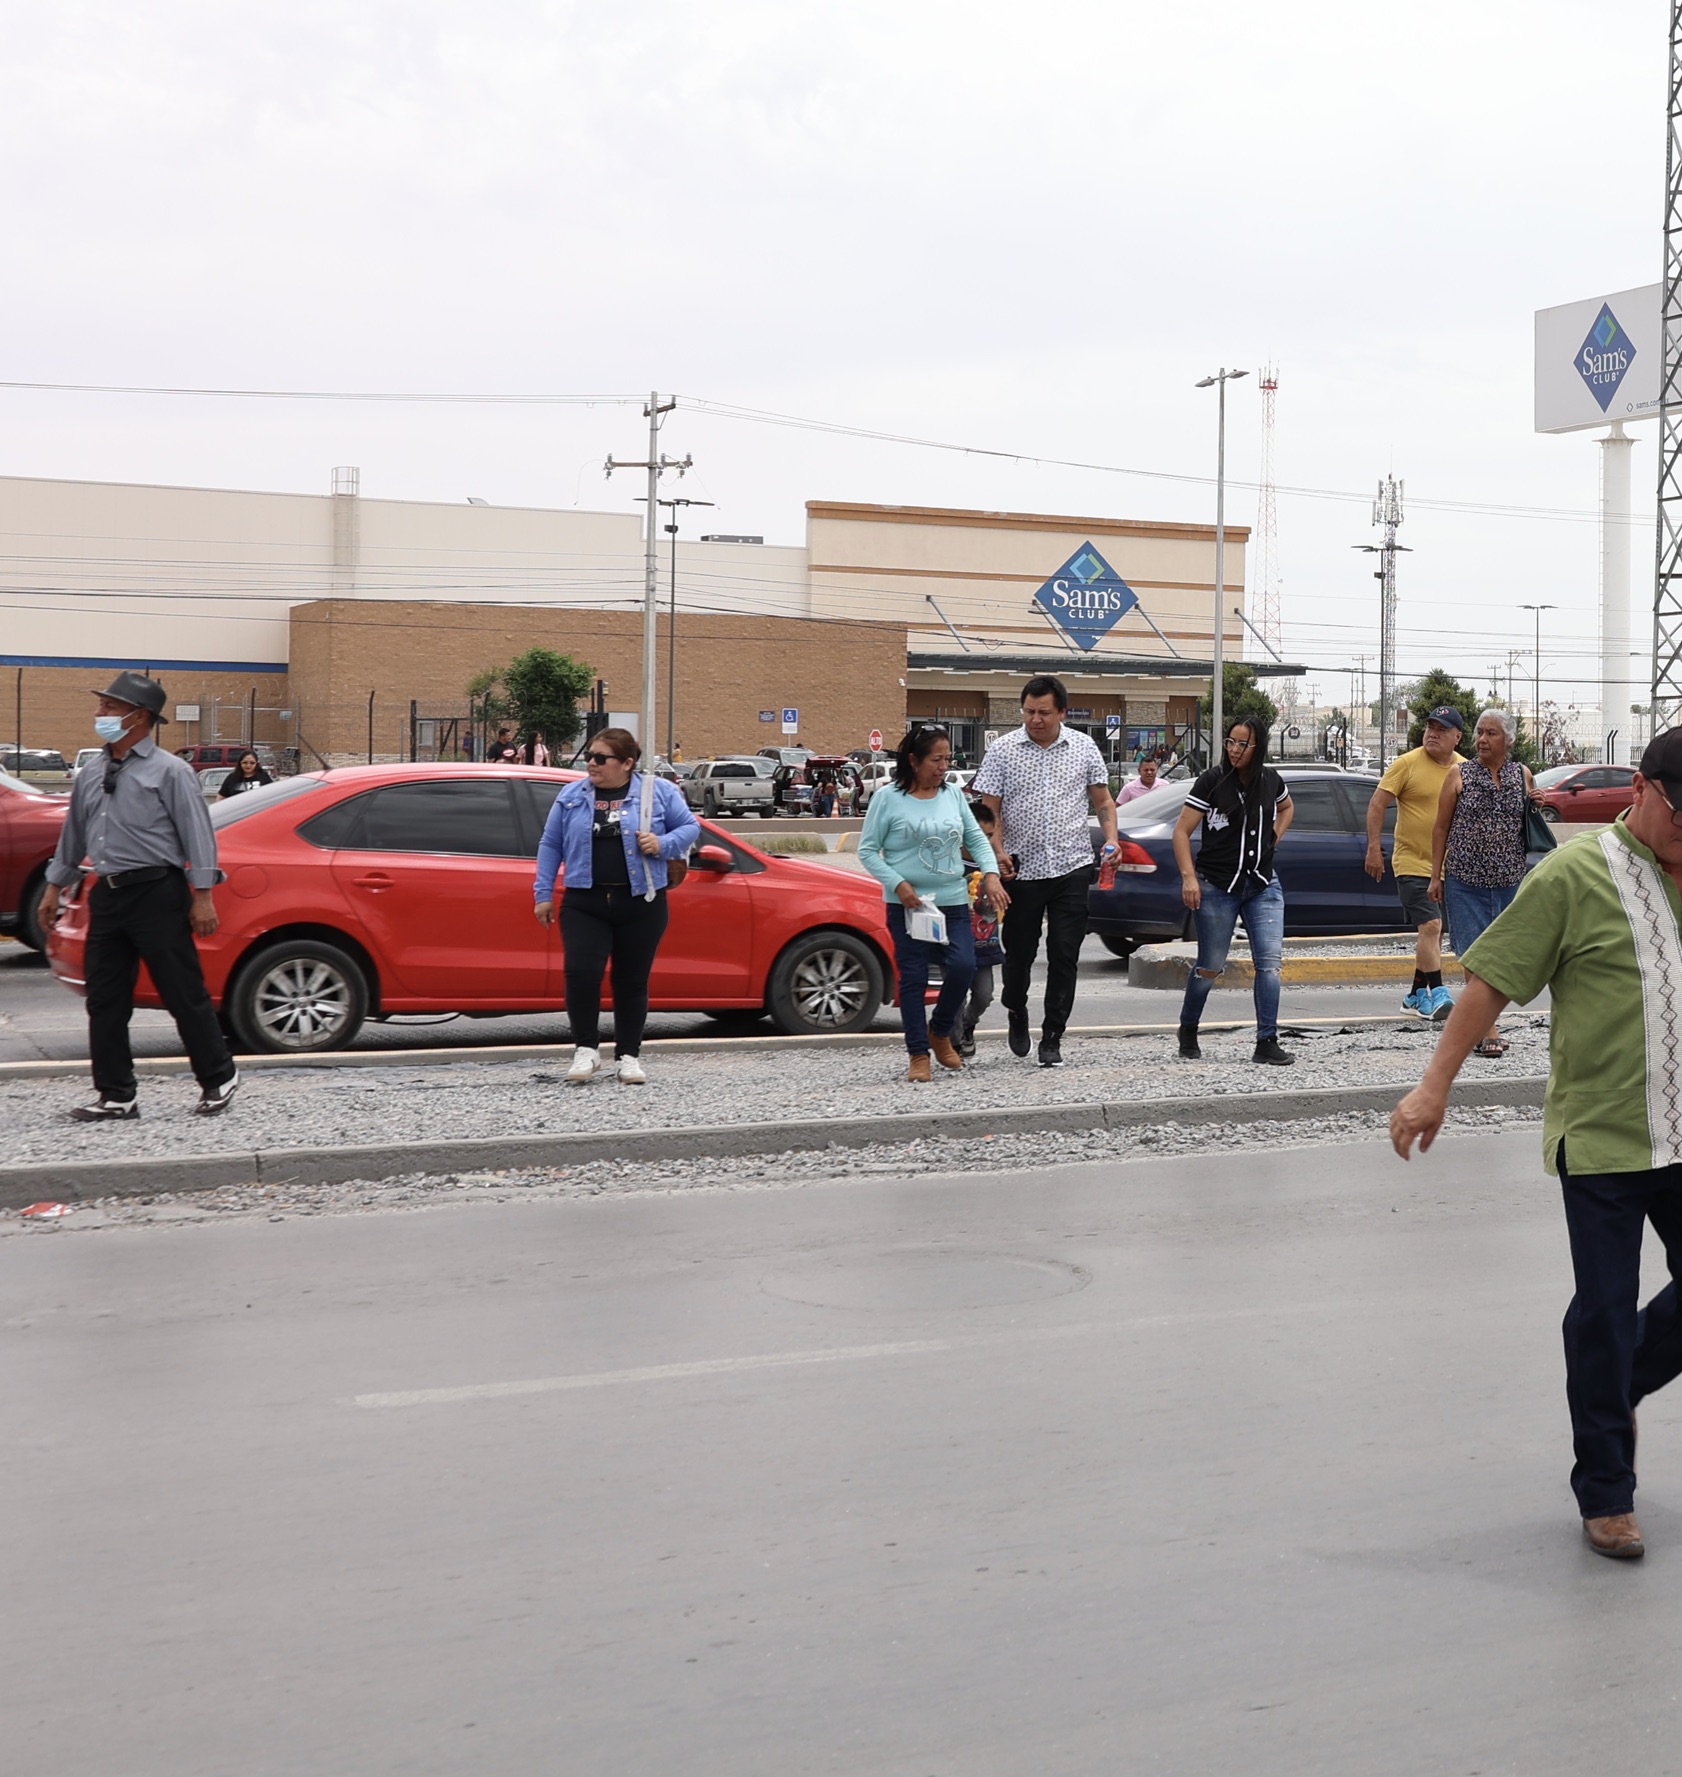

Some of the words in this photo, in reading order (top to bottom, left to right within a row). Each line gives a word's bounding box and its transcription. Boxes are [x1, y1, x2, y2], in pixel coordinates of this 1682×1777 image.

[1582, 347, 1627, 376] Sam's
[1593, 372, 1617, 384] CLUB
[1052, 579, 1121, 611] Sam's
[1068, 609, 1105, 619] CLUB
[870, 736, 882, 745] ALTO
